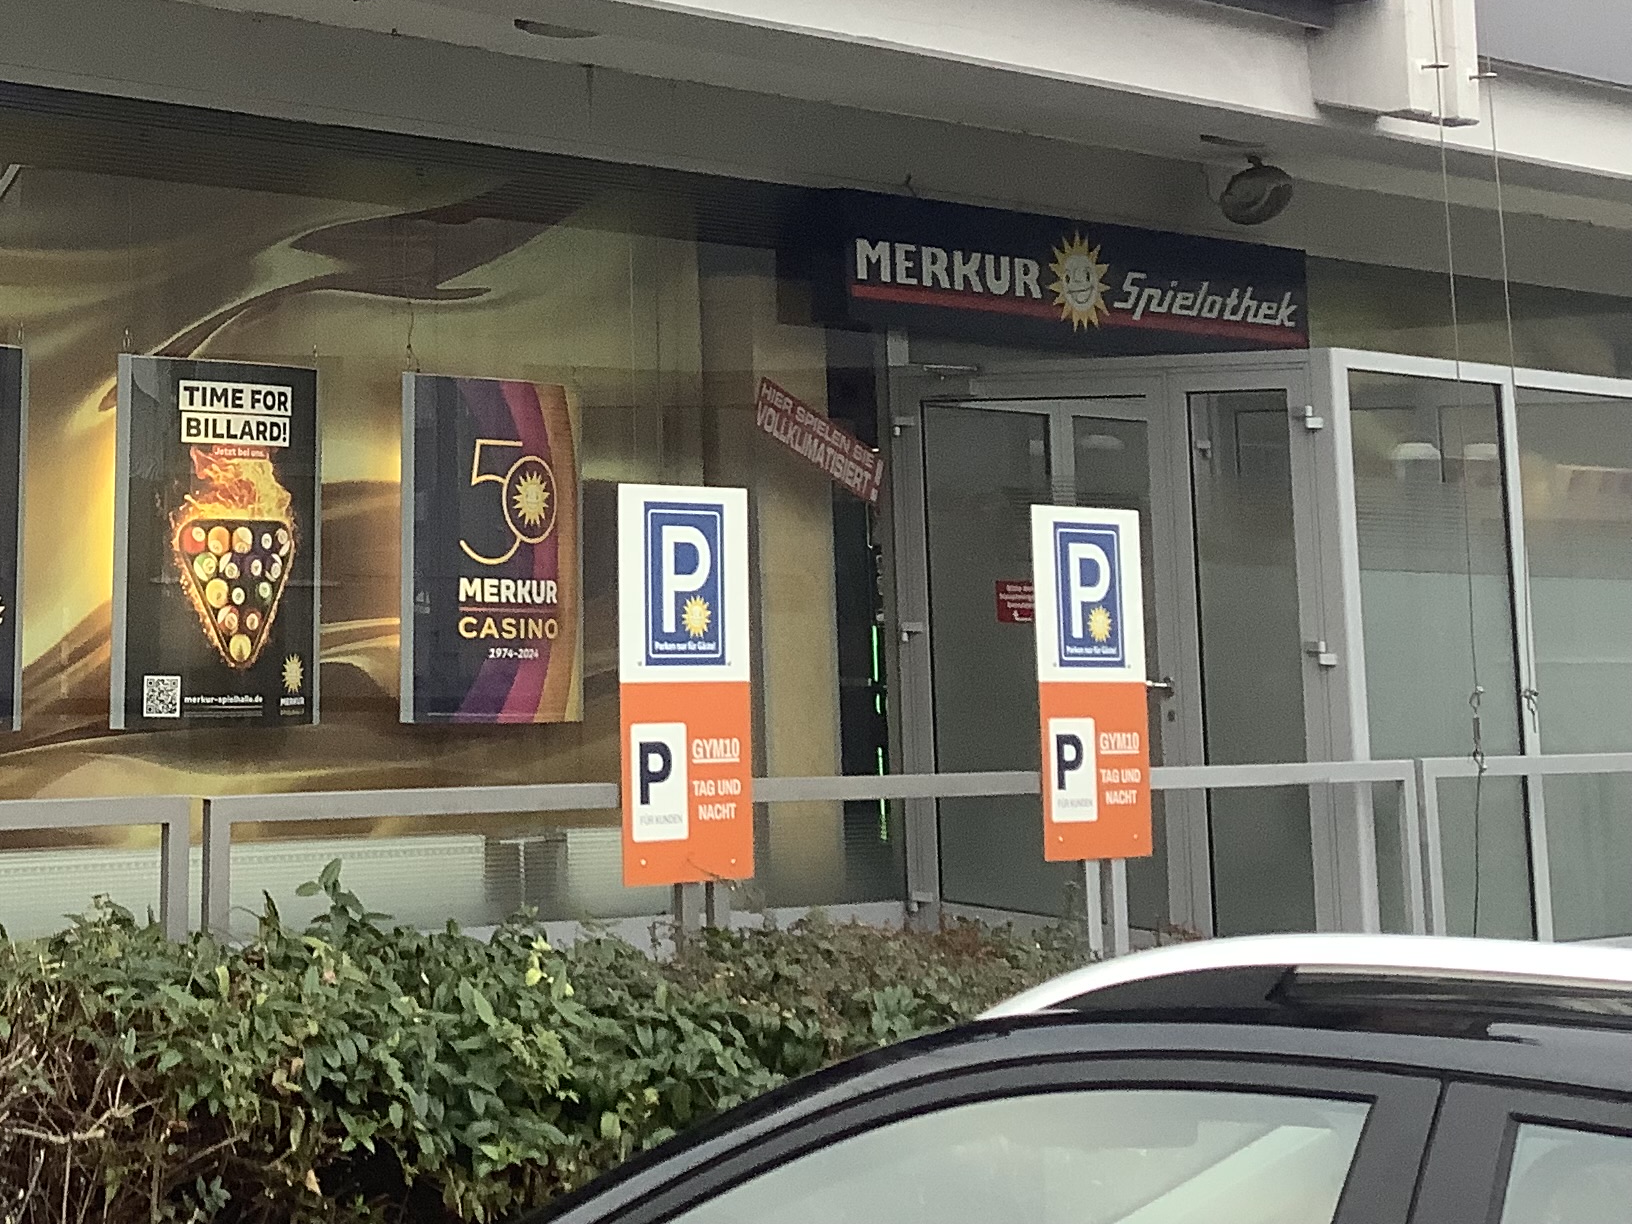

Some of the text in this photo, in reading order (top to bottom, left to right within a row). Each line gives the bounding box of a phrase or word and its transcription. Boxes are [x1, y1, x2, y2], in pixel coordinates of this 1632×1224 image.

[855, 238, 1298, 327] MERKUR Spielothek
[184, 386, 288, 412] TIME FOR
[761, 382, 793, 414] HIER
[795, 406, 850, 454] SPIELEN
[186, 417, 287, 443] BILLARD!
[214, 447, 237, 457] Jetzt
[237, 447, 250, 457] bei
[458, 577, 558, 604] MERKUR
[661, 525, 711, 633] P
[1068, 542, 1111, 639] P
[458, 616, 559, 639] CASINO
[488, 647, 539, 659] 1974-2024
[184, 695, 263, 705] merkur-spielhalle.de
[692, 738, 741, 760] GYM10
[1099, 732, 1140, 751] GYM10
[639, 741, 673, 805] P
[1056, 733, 1084, 791] P
[1100, 767, 1142, 784] TAG UND
[693, 778, 742, 797] TAG UND
[1105, 789, 1137, 805] NACHT
[698, 802, 737, 821] NACHT
